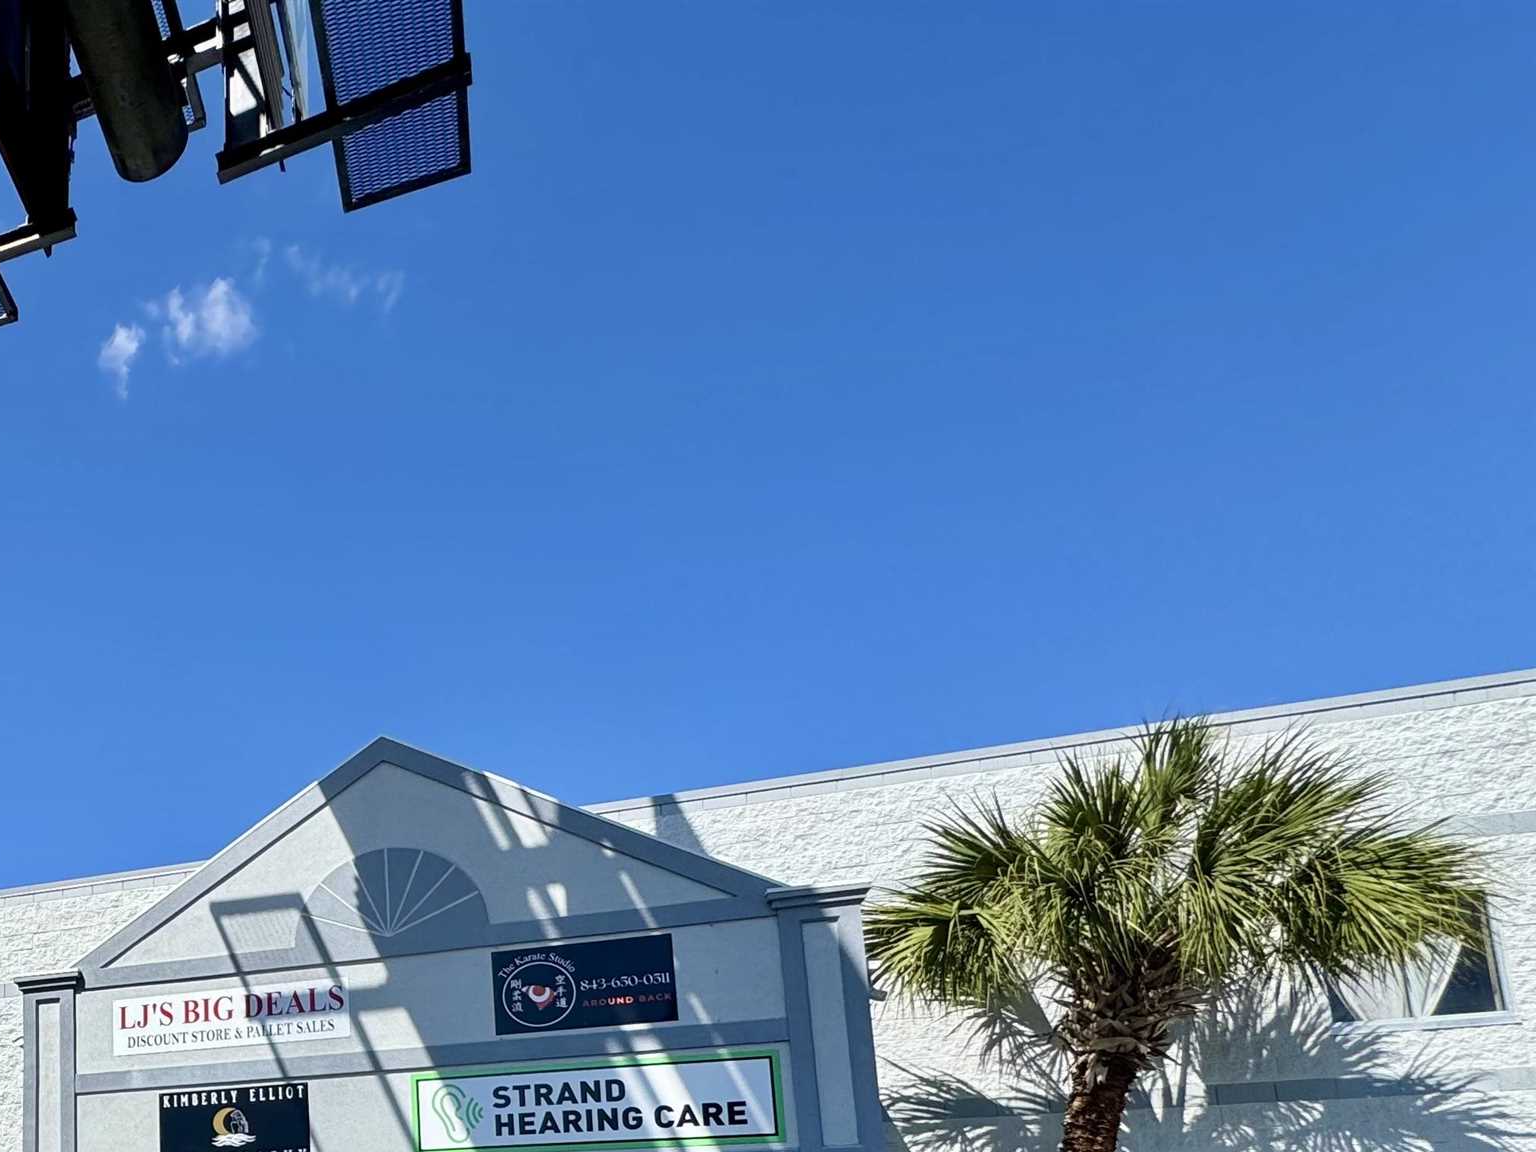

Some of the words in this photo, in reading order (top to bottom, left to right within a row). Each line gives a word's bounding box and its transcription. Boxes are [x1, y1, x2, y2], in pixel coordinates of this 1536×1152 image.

[497, 963, 515, 978] The
[514, 953, 546, 966] Karate
[548, 952, 576, 973] Studio
[120, 1002, 174, 1030] LJ'S
[183, 996, 234, 1024] BIG
[244, 985, 345, 1019] DEALS
[582, 996, 634, 1007] AROUND
[639, 993, 672, 1003] BACK
[127, 1031, 189, 1048] DISCOUNT
[191, 1027, 231, 1043] STORE
[234, 1027, 243, 1039] &
[246, 1022, 293, 1038] PALLET
[296, 1018, 336, 1033] SALES
[163, 1090, 238, 1108] KIMBERLY
[249, 1085, 304, 1102] ELLIOT
[492, 1078, 626, 1109] STRAND
[494, 1107, 643, 1137] HEARING
[654, 1101, 748, 1128] CARE
